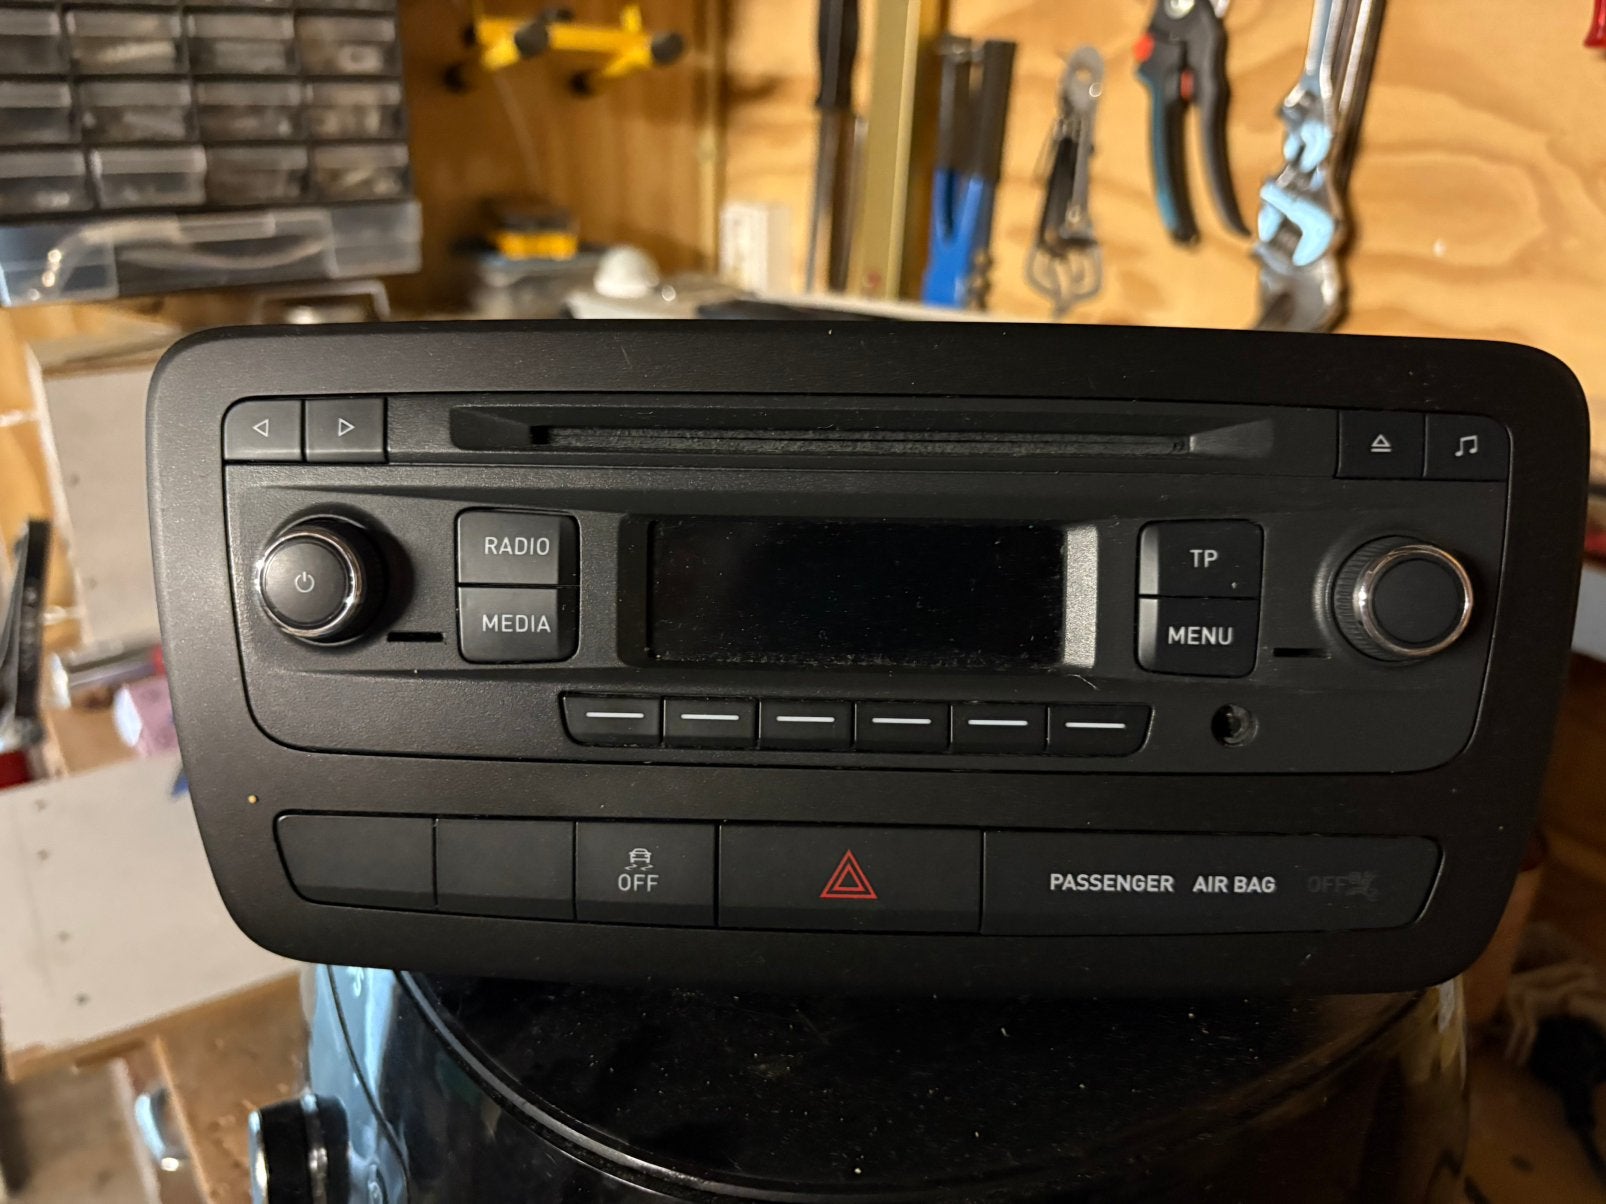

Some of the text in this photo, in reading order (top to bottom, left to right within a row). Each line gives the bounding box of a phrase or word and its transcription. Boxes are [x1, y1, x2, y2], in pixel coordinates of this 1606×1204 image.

[483, 536, 550, 557] RADIO
[1190, 549, 1219, 568] TP
[481, 613, 551, 634] MEDIA
[1167, 627, 1234, 647] MENU
[616, 873, 659, 893] OFF
[1049, 873, 1346, 894] PASSENGER AIR BAG OFF
